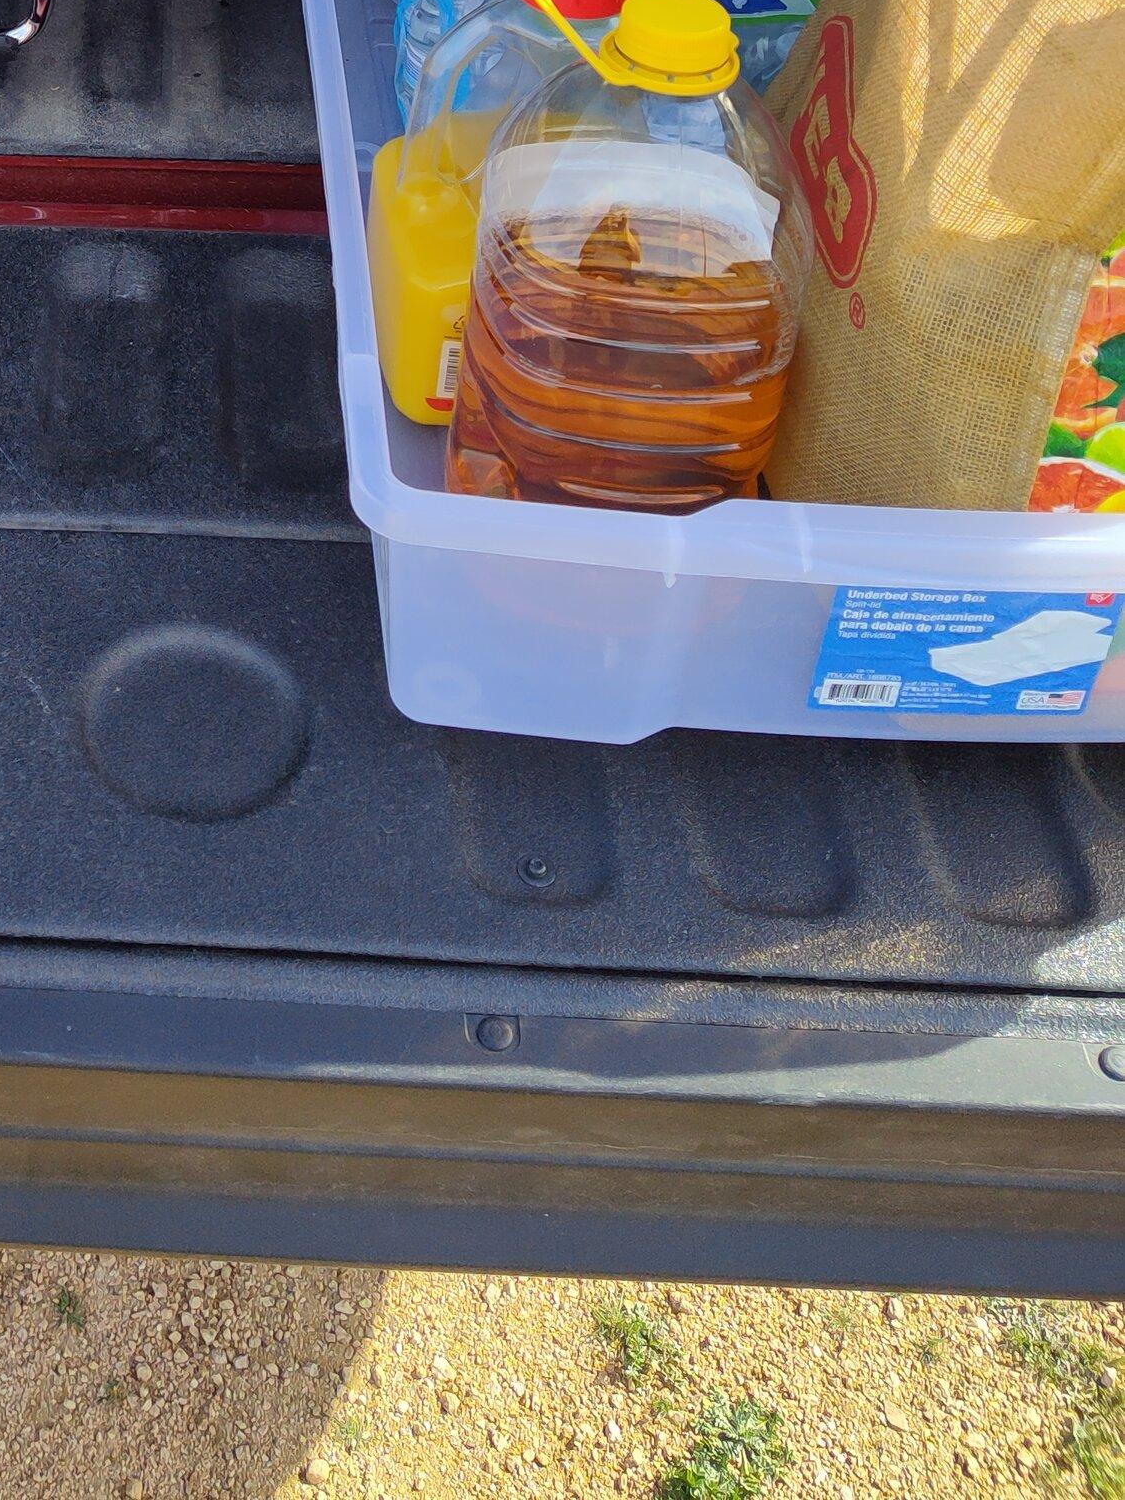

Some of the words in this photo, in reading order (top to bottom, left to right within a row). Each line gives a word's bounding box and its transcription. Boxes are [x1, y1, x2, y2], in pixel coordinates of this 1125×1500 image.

[847, 589, 909, 601] Underbed
[911, 591, 959, 604] Storage
[962, 593, 988, 603] Box
[843, 609, 870, 620] Caja
[873, 610, 889, 620] de
[891, 611, 995, 623] almacenamiento
[838, 620, 868, 632] para
[871, 621, 913, 632] debajo
[916, 623, 932, 633] de
[934, 623, 946, 632] la
[948, 624, 984, 633] cama
[837, 631, 859, 640] Tapa
[861, 631, 896, 640] dividida
